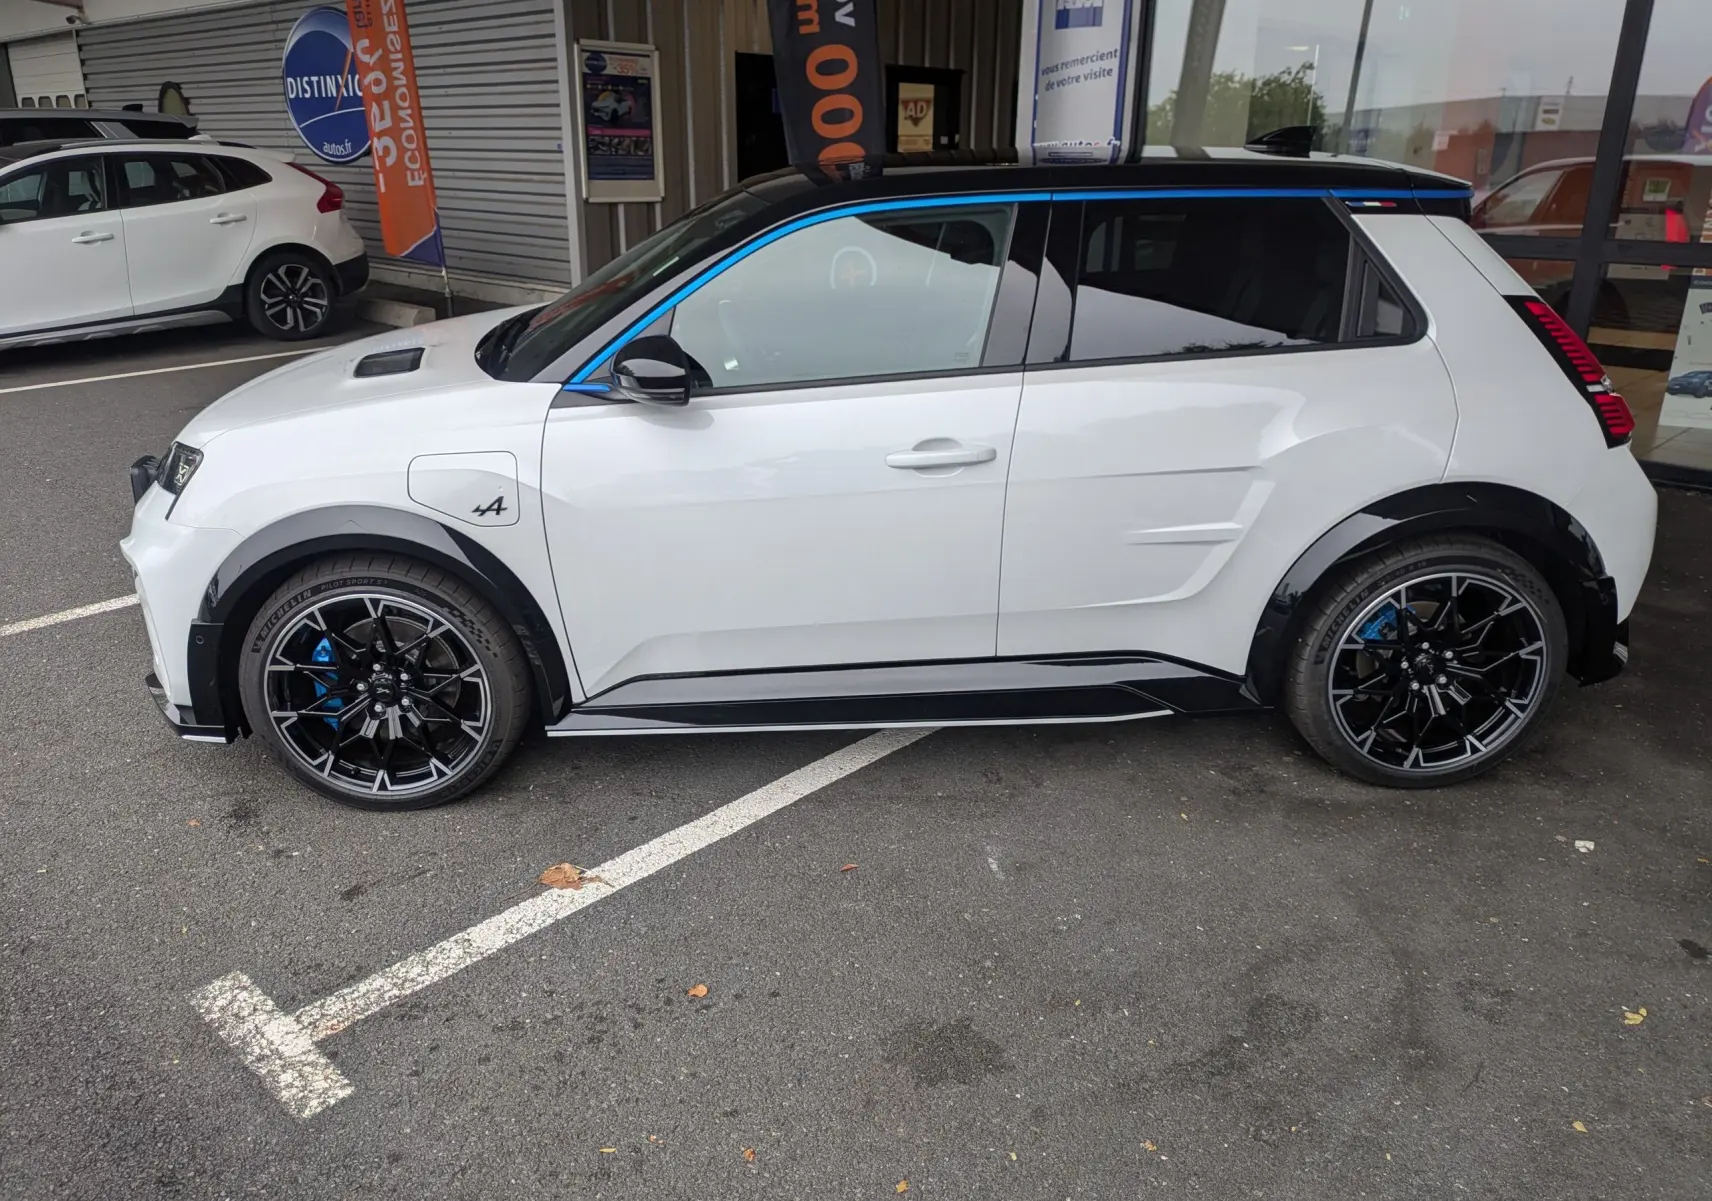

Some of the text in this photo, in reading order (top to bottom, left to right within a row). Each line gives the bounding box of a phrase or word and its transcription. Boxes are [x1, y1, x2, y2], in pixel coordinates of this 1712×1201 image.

[1041, 48, 1118, 76] vous remercient
[286, 74, 363, 99] DISTINXIO
[1045, 67, 1113, 92] de votre visite
[322, 139, 352, 156] autos.fr
[260, 589, 312, 639] MICHELIN
[321, 580, 344, 590] PILOT
[1322, 589, 1369, 648] MICHELIN
